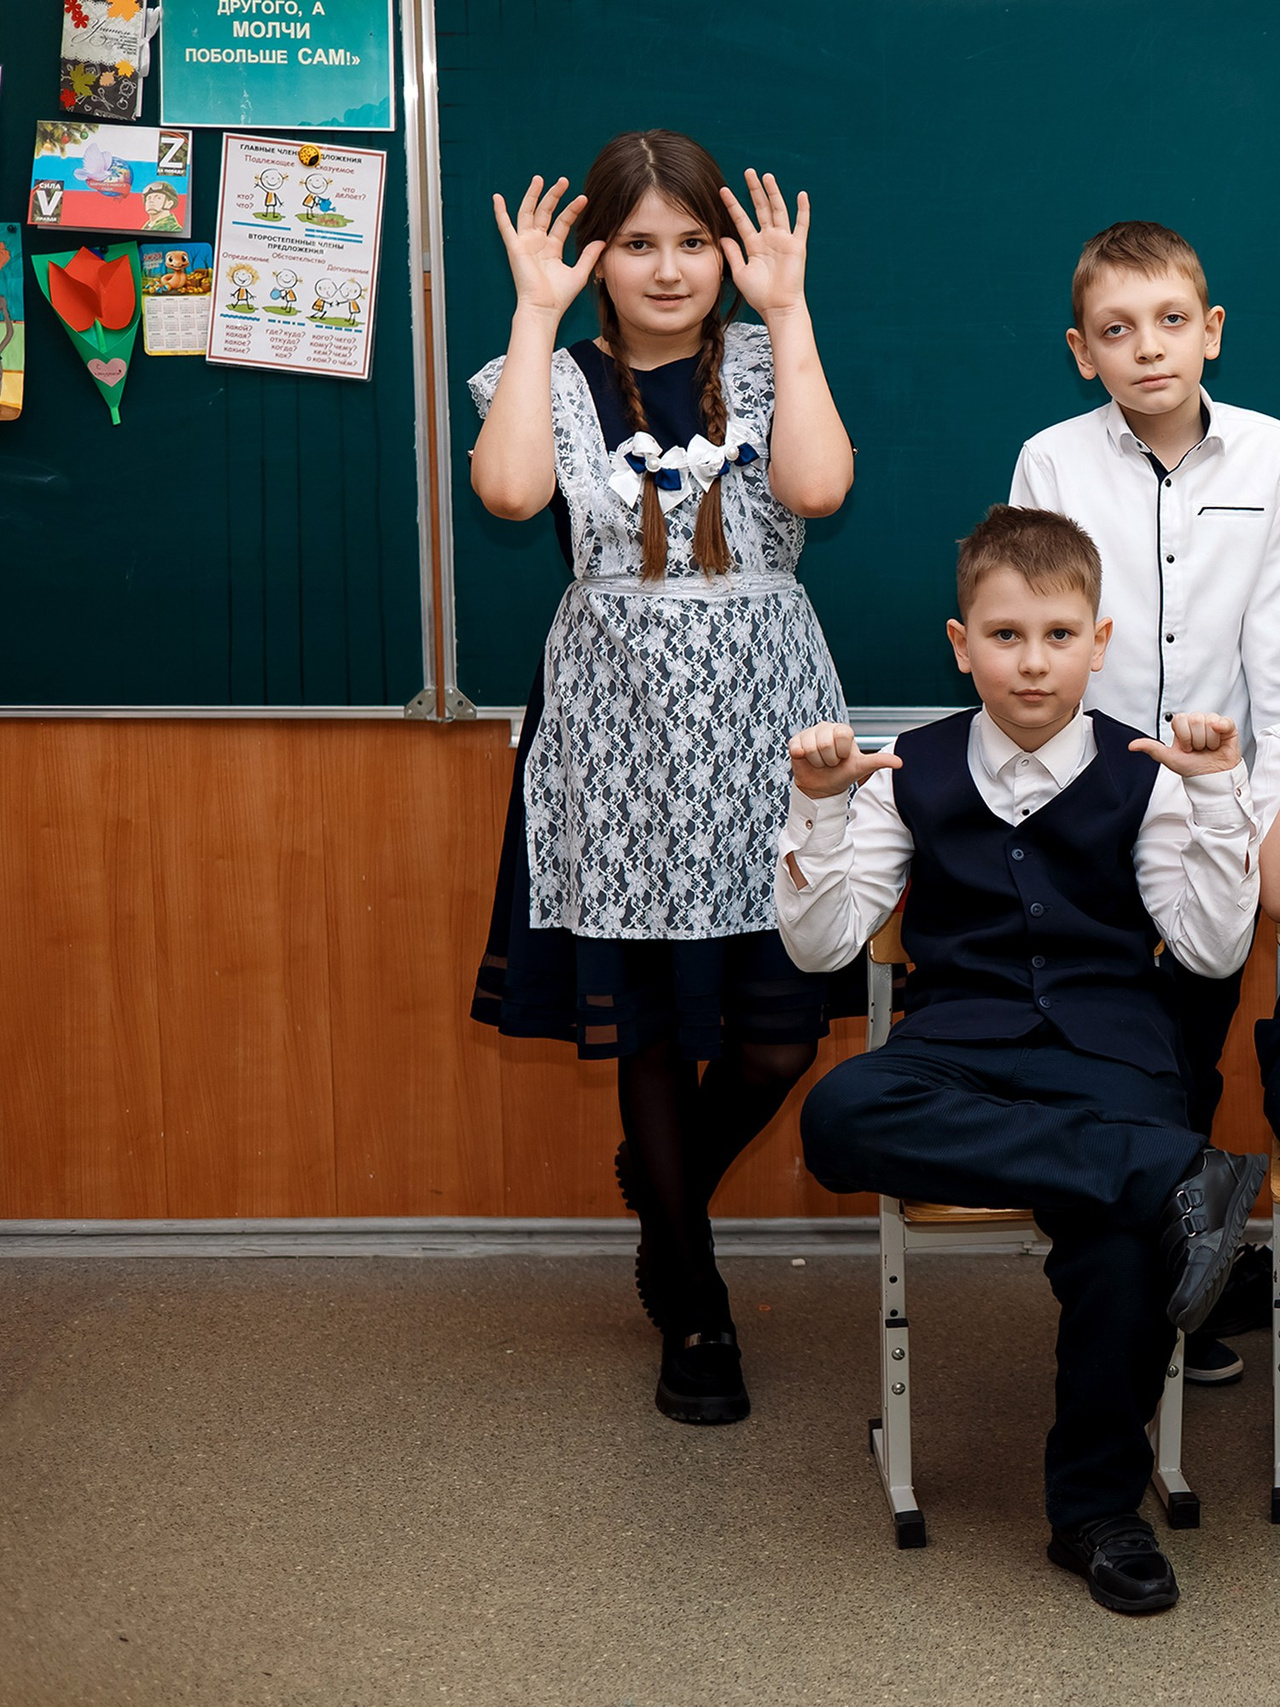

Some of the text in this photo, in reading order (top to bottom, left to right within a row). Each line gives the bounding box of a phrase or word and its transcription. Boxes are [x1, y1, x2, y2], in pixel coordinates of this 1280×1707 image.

[217, 0, 325, 17] ДРУГОГО, А
[232, 21, 311, 39] МОЛЧИ
[185, 47, 361, 66] ПОБОЛЬШЕ САМ!»
[159, 137, 185, 168] Z
[240, 144, 275, 154] ГЛАВНЫЕ
[277, 148, 300, 156] ЧЛЕН
[244, 155, 295, 167] Подлежащее
[314, 164, 355, 175] Сказуемое
[36, 190, 63, 215] V
[237, 193, 254, 201] кто?
[335, 193, 367, 201] делает?
[236, 202, 254, 210] что?
[248, 233, 344, 250] ВТОРОСТЕПЕННЫЕ ЧЛЕНЫ
[267, 243, 324, 255] ПРЕДЛОЖЕНИЯ
[222, 252, 269, 263] Определение
[272, 252, 326, 265] Обстоятельство
[225, 324, 253, 332] какой?
[225, 331, 252, 339] какая?
[312, 334, 334, 342] кого?
[223, 346, 251, 354] какие?
[310, 342, 333, 350] кому?
